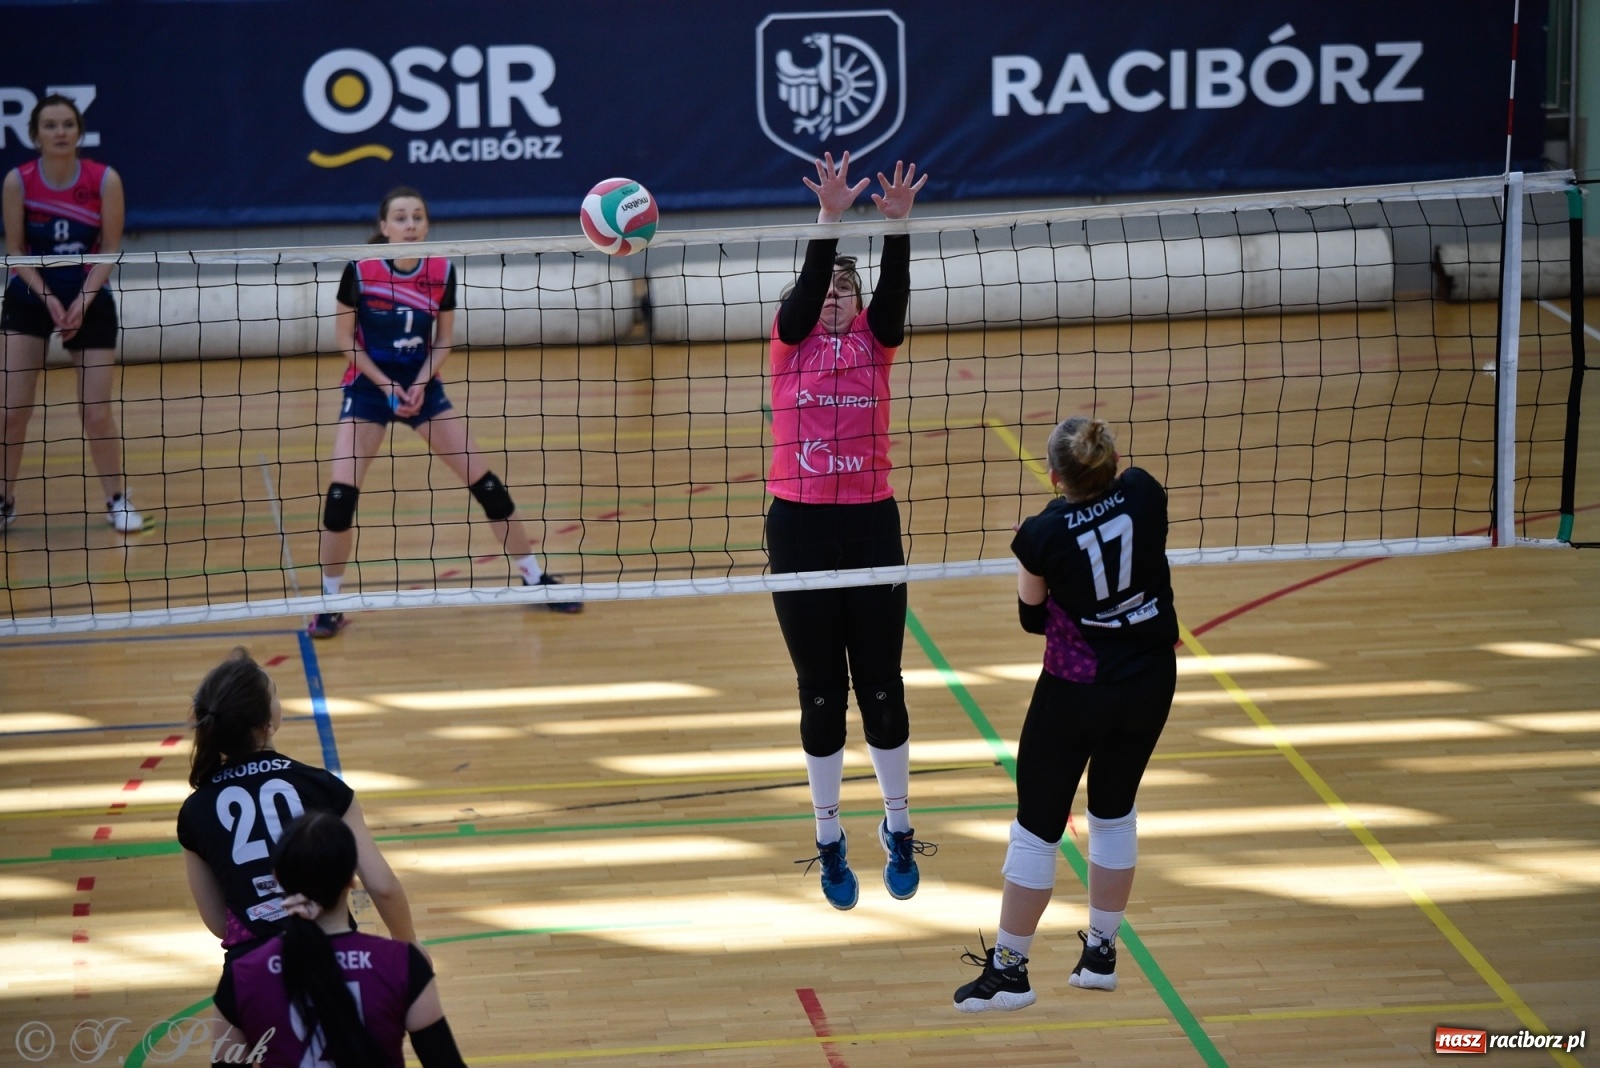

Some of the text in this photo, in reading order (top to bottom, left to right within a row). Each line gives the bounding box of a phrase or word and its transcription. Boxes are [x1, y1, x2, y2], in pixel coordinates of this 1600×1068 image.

[992, 23, 1424, 117] RACIBÓRZ
[407, 130, 563, 164] RACIBÓRZ
[54, 219, 69, 241] 8
[816, 394, 879, 409] TAURON
[826, 454, 864, 474] JSW
[1076, 513, 1134, 601] 17
[212, 758, 292, 784] GROBOSZ
[216, 778, 305, 866] 20
